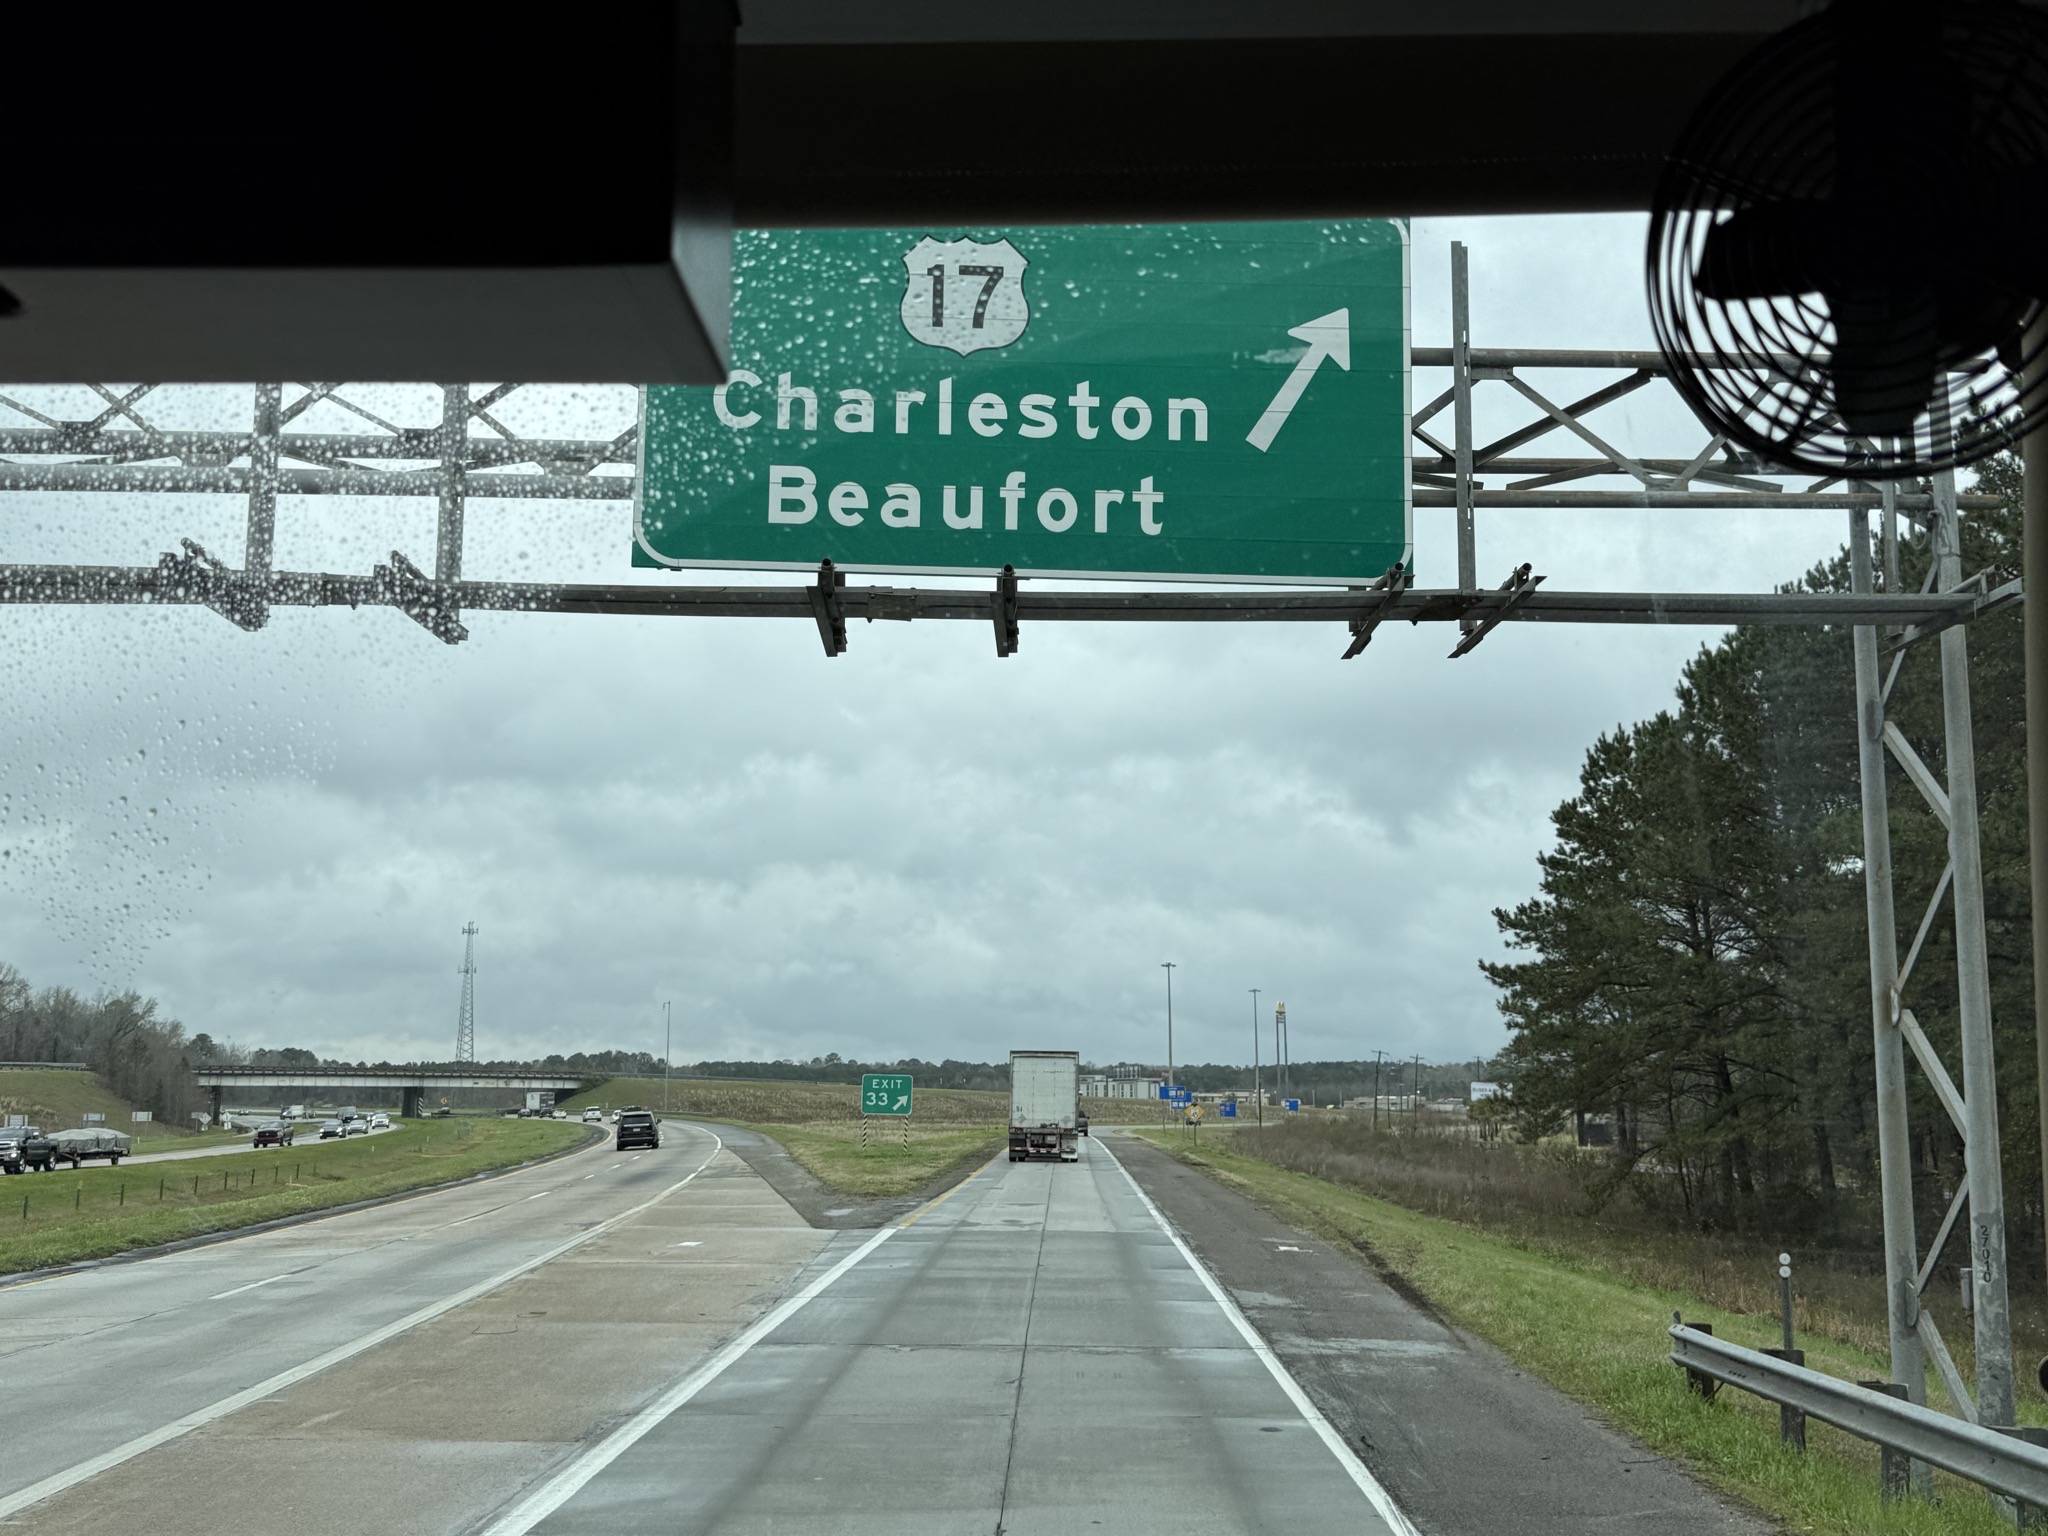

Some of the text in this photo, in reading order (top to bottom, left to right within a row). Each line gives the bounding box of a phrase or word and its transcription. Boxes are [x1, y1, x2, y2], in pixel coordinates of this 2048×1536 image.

[927, 264, 1004, 329] 17
[713, 369, 1208, 442] Charleston
[768, 465, 1164, 536] Beaufort
[866, 1092, 888, 1106] 33
[872, 1079, 903, 1089] EXIT
